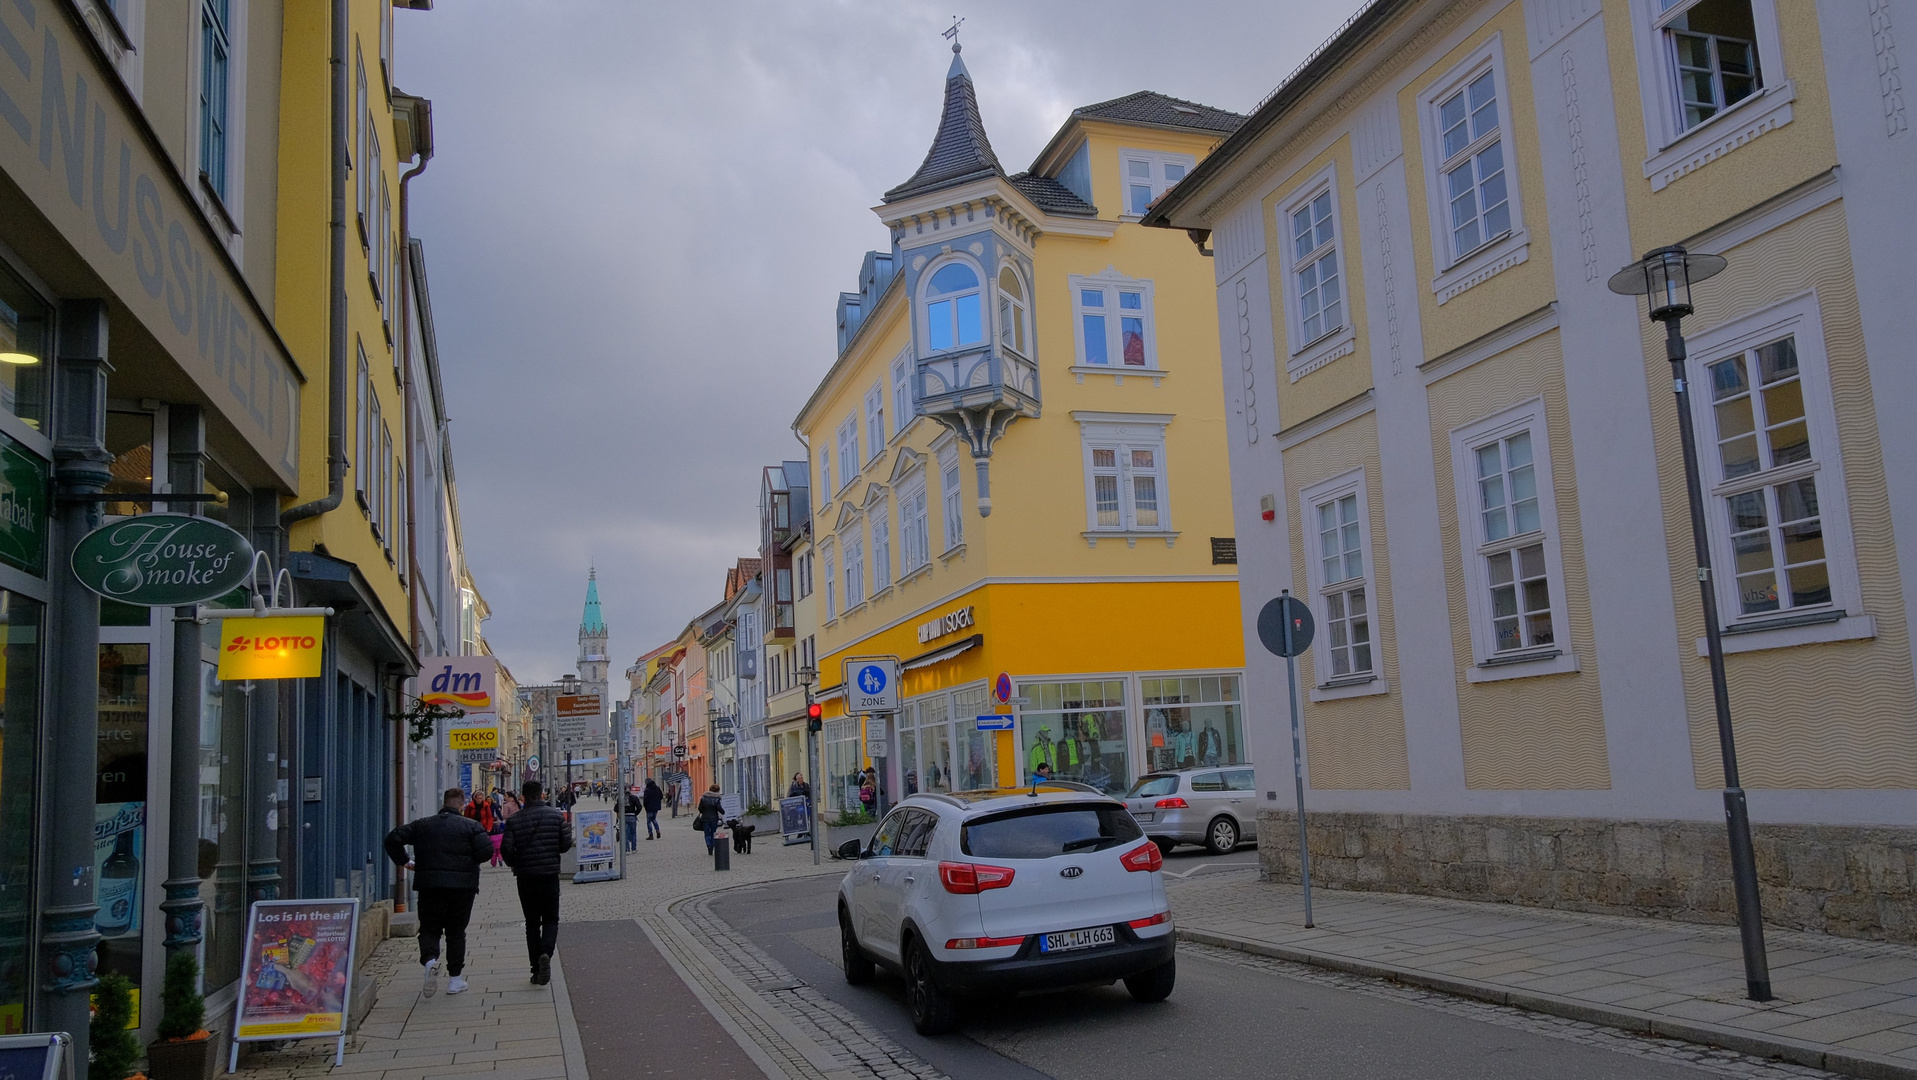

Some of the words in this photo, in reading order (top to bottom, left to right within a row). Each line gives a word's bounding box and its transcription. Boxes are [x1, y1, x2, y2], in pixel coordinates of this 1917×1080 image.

[96, 521, 216, 564] House
[213, 551, 234, 574] of
[102, 553, 214, 594] Smoke
[1743, 588, 1766, 602] vhs
[1498, 628, 1514, 640] vhs
[254, 636, 316, 651] LOTTO
[431, 665, 482, 692] dm
[861, 697, 885, 707] ZONE
[463, 752, 496, 761] HÖREN
[1063, 867, 1080, 877] KIA
[258, 913, 280, 923] Los
[282, 912, 293, 922] is
[295, 911, 307, 921] in
[309, 911, 330, 921] the
[332, 910, 350, 920] air
[1048, 935, 1068, 949] SHL
[1076, 931, 1090, 945] LH
[1093, 928, 1113, 943] 663
